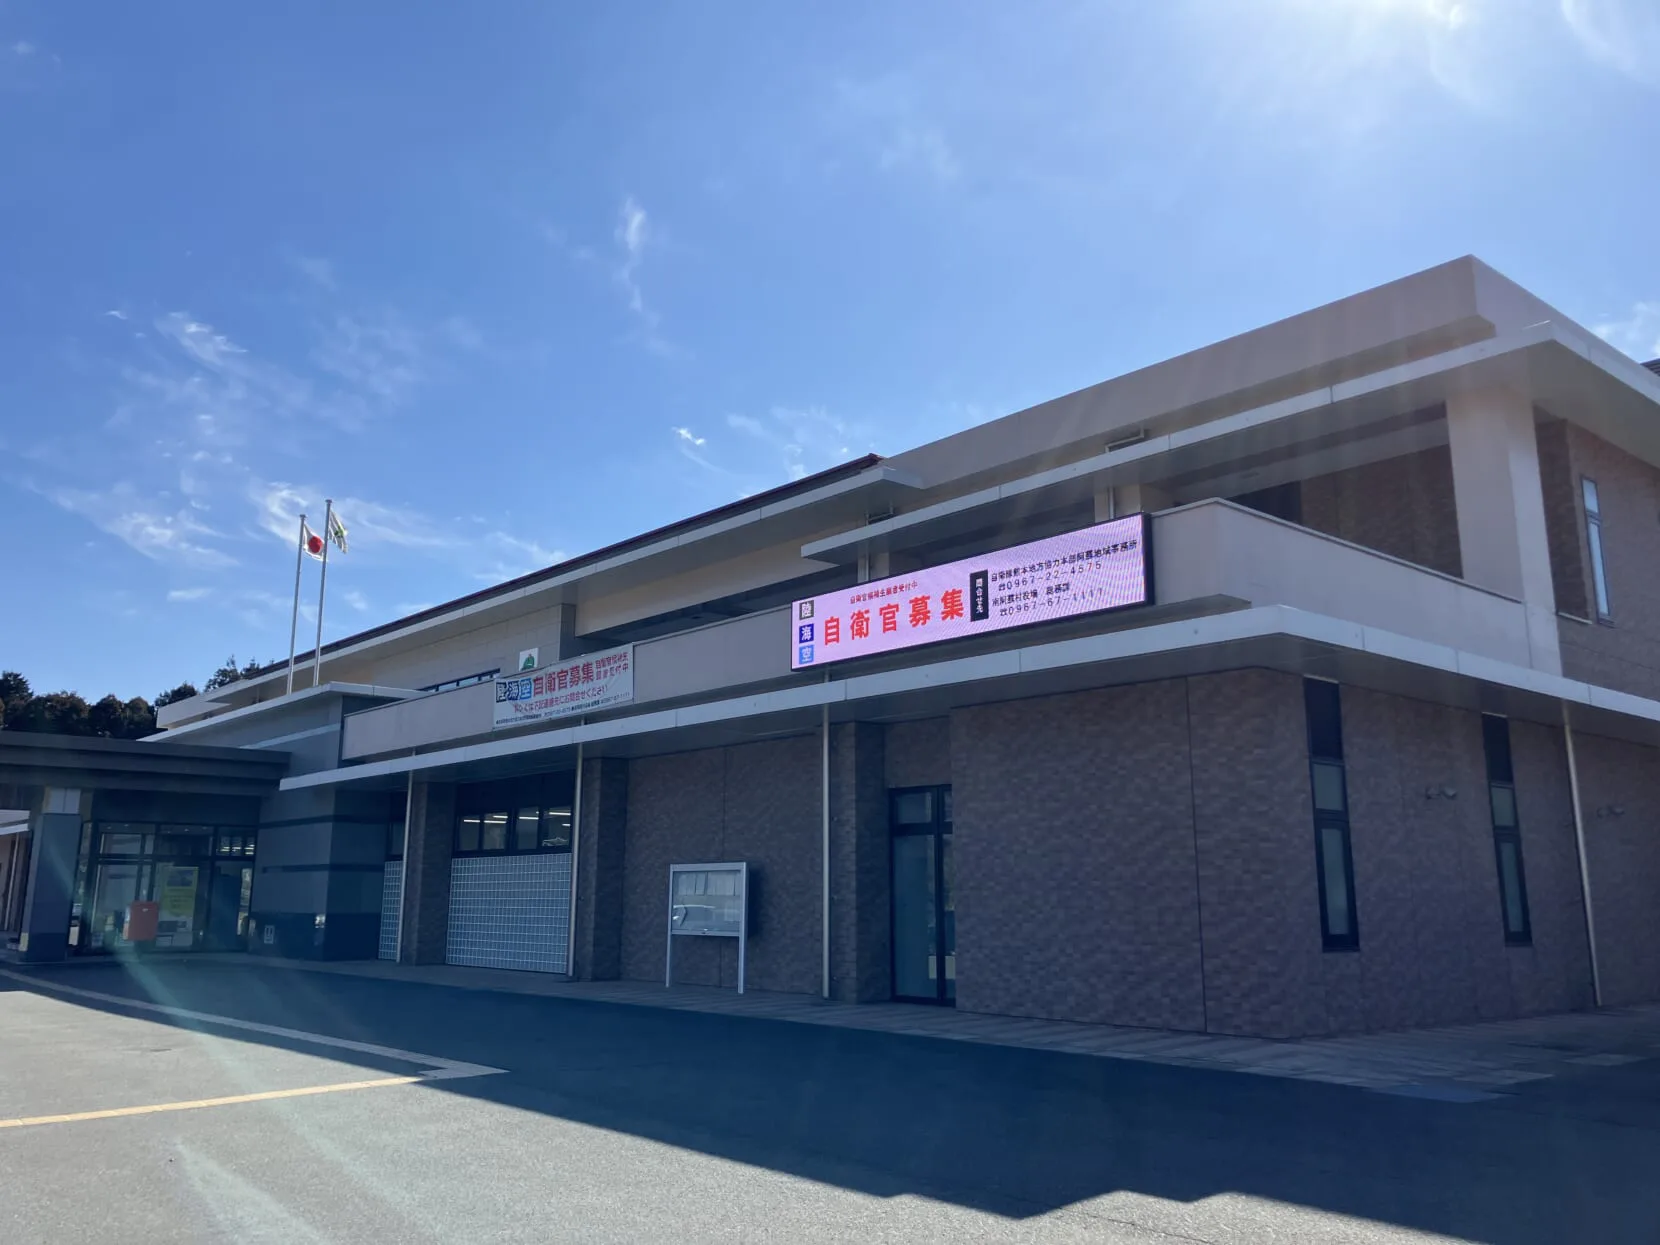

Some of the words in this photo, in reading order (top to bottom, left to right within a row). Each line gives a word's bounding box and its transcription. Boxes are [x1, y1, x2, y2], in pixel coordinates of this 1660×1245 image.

[824, 588, 964, 645] 自衛官募集
[533, 661, 594, 697] 自衛官募集
